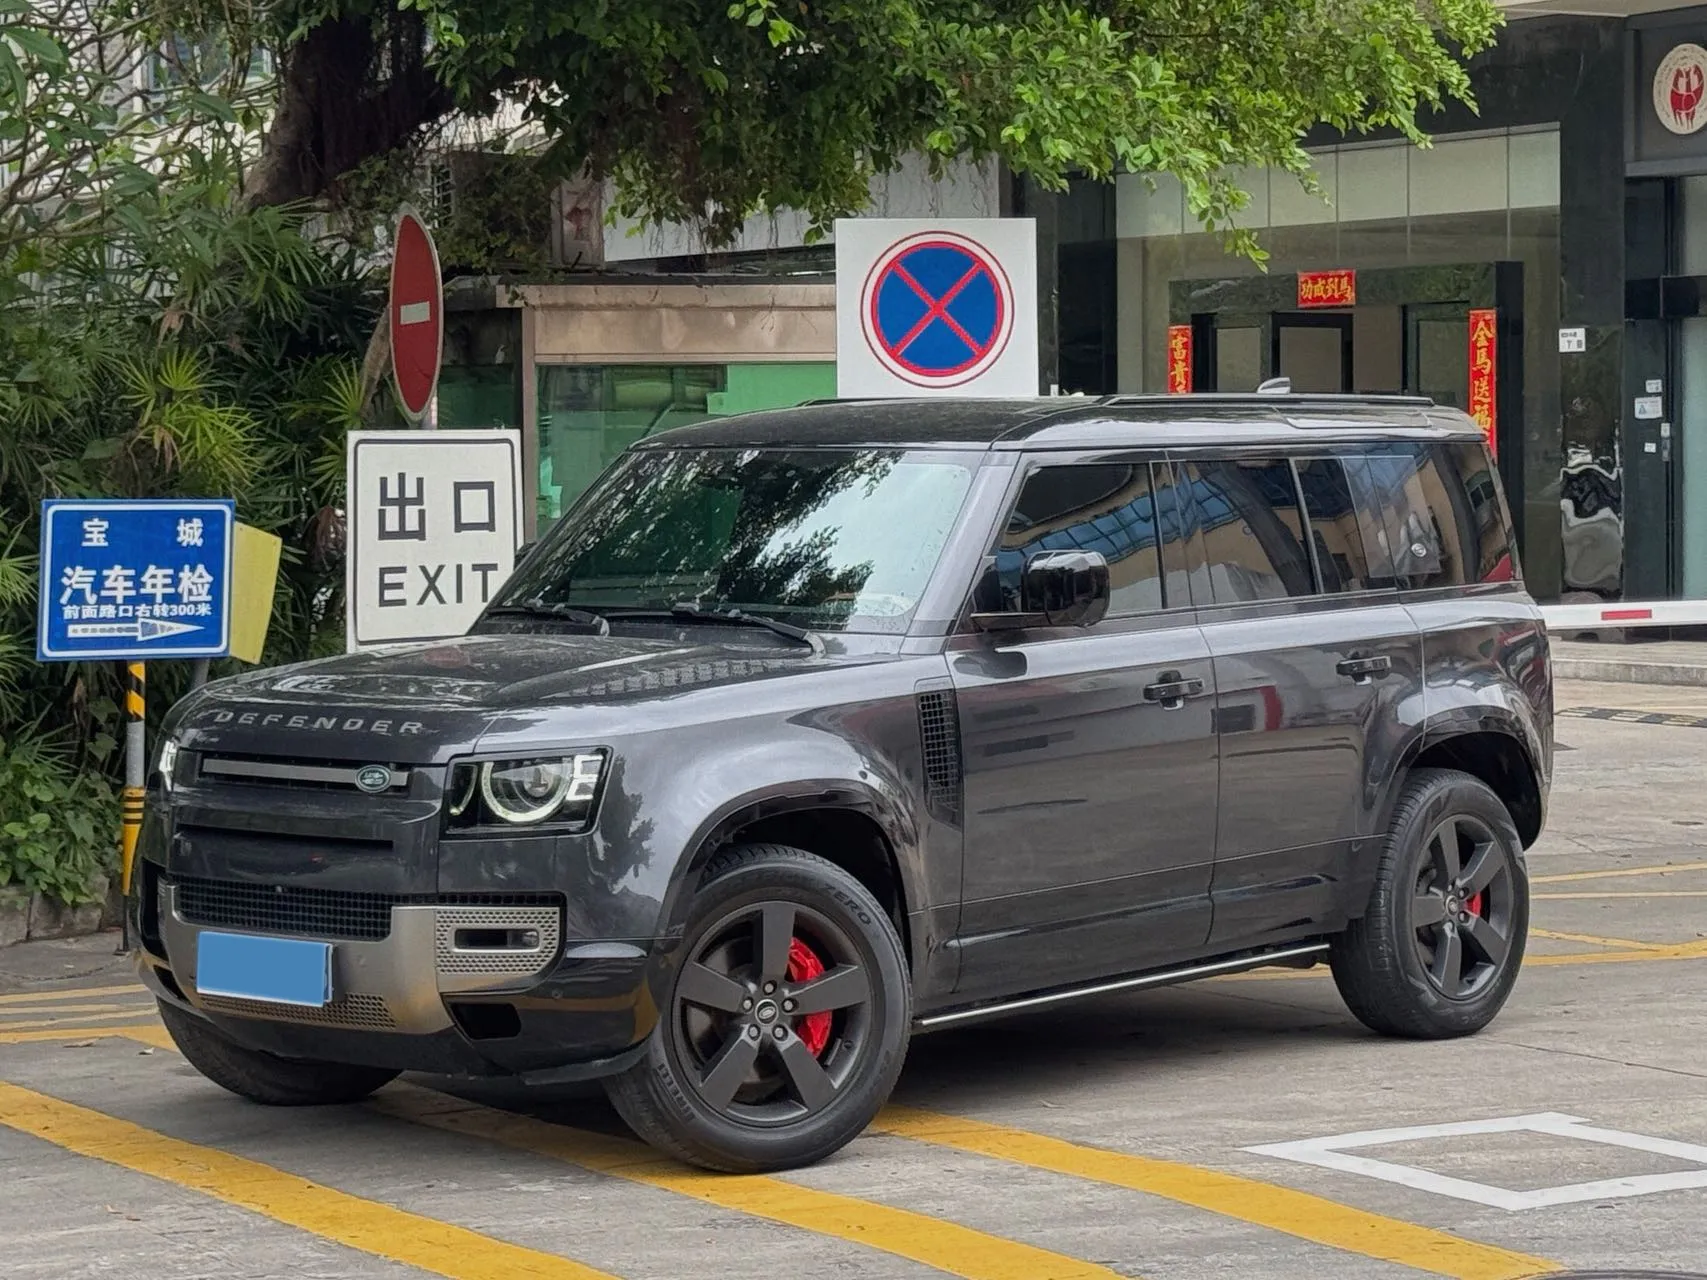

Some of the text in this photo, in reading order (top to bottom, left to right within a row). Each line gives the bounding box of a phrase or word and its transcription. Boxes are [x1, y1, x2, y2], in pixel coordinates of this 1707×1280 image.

[378, 472, 496, 541] 出口
[81, 517, 204, 547] 宝城
[59, 563, 215, 605] 汽车年检
[378, 563, 498, 607] EXIT
[62, 603, 212, 620] 前面路口右转300米
[213, 711, 424, 735] DEFENDER
[823, 883, 872, 926] ZERO
